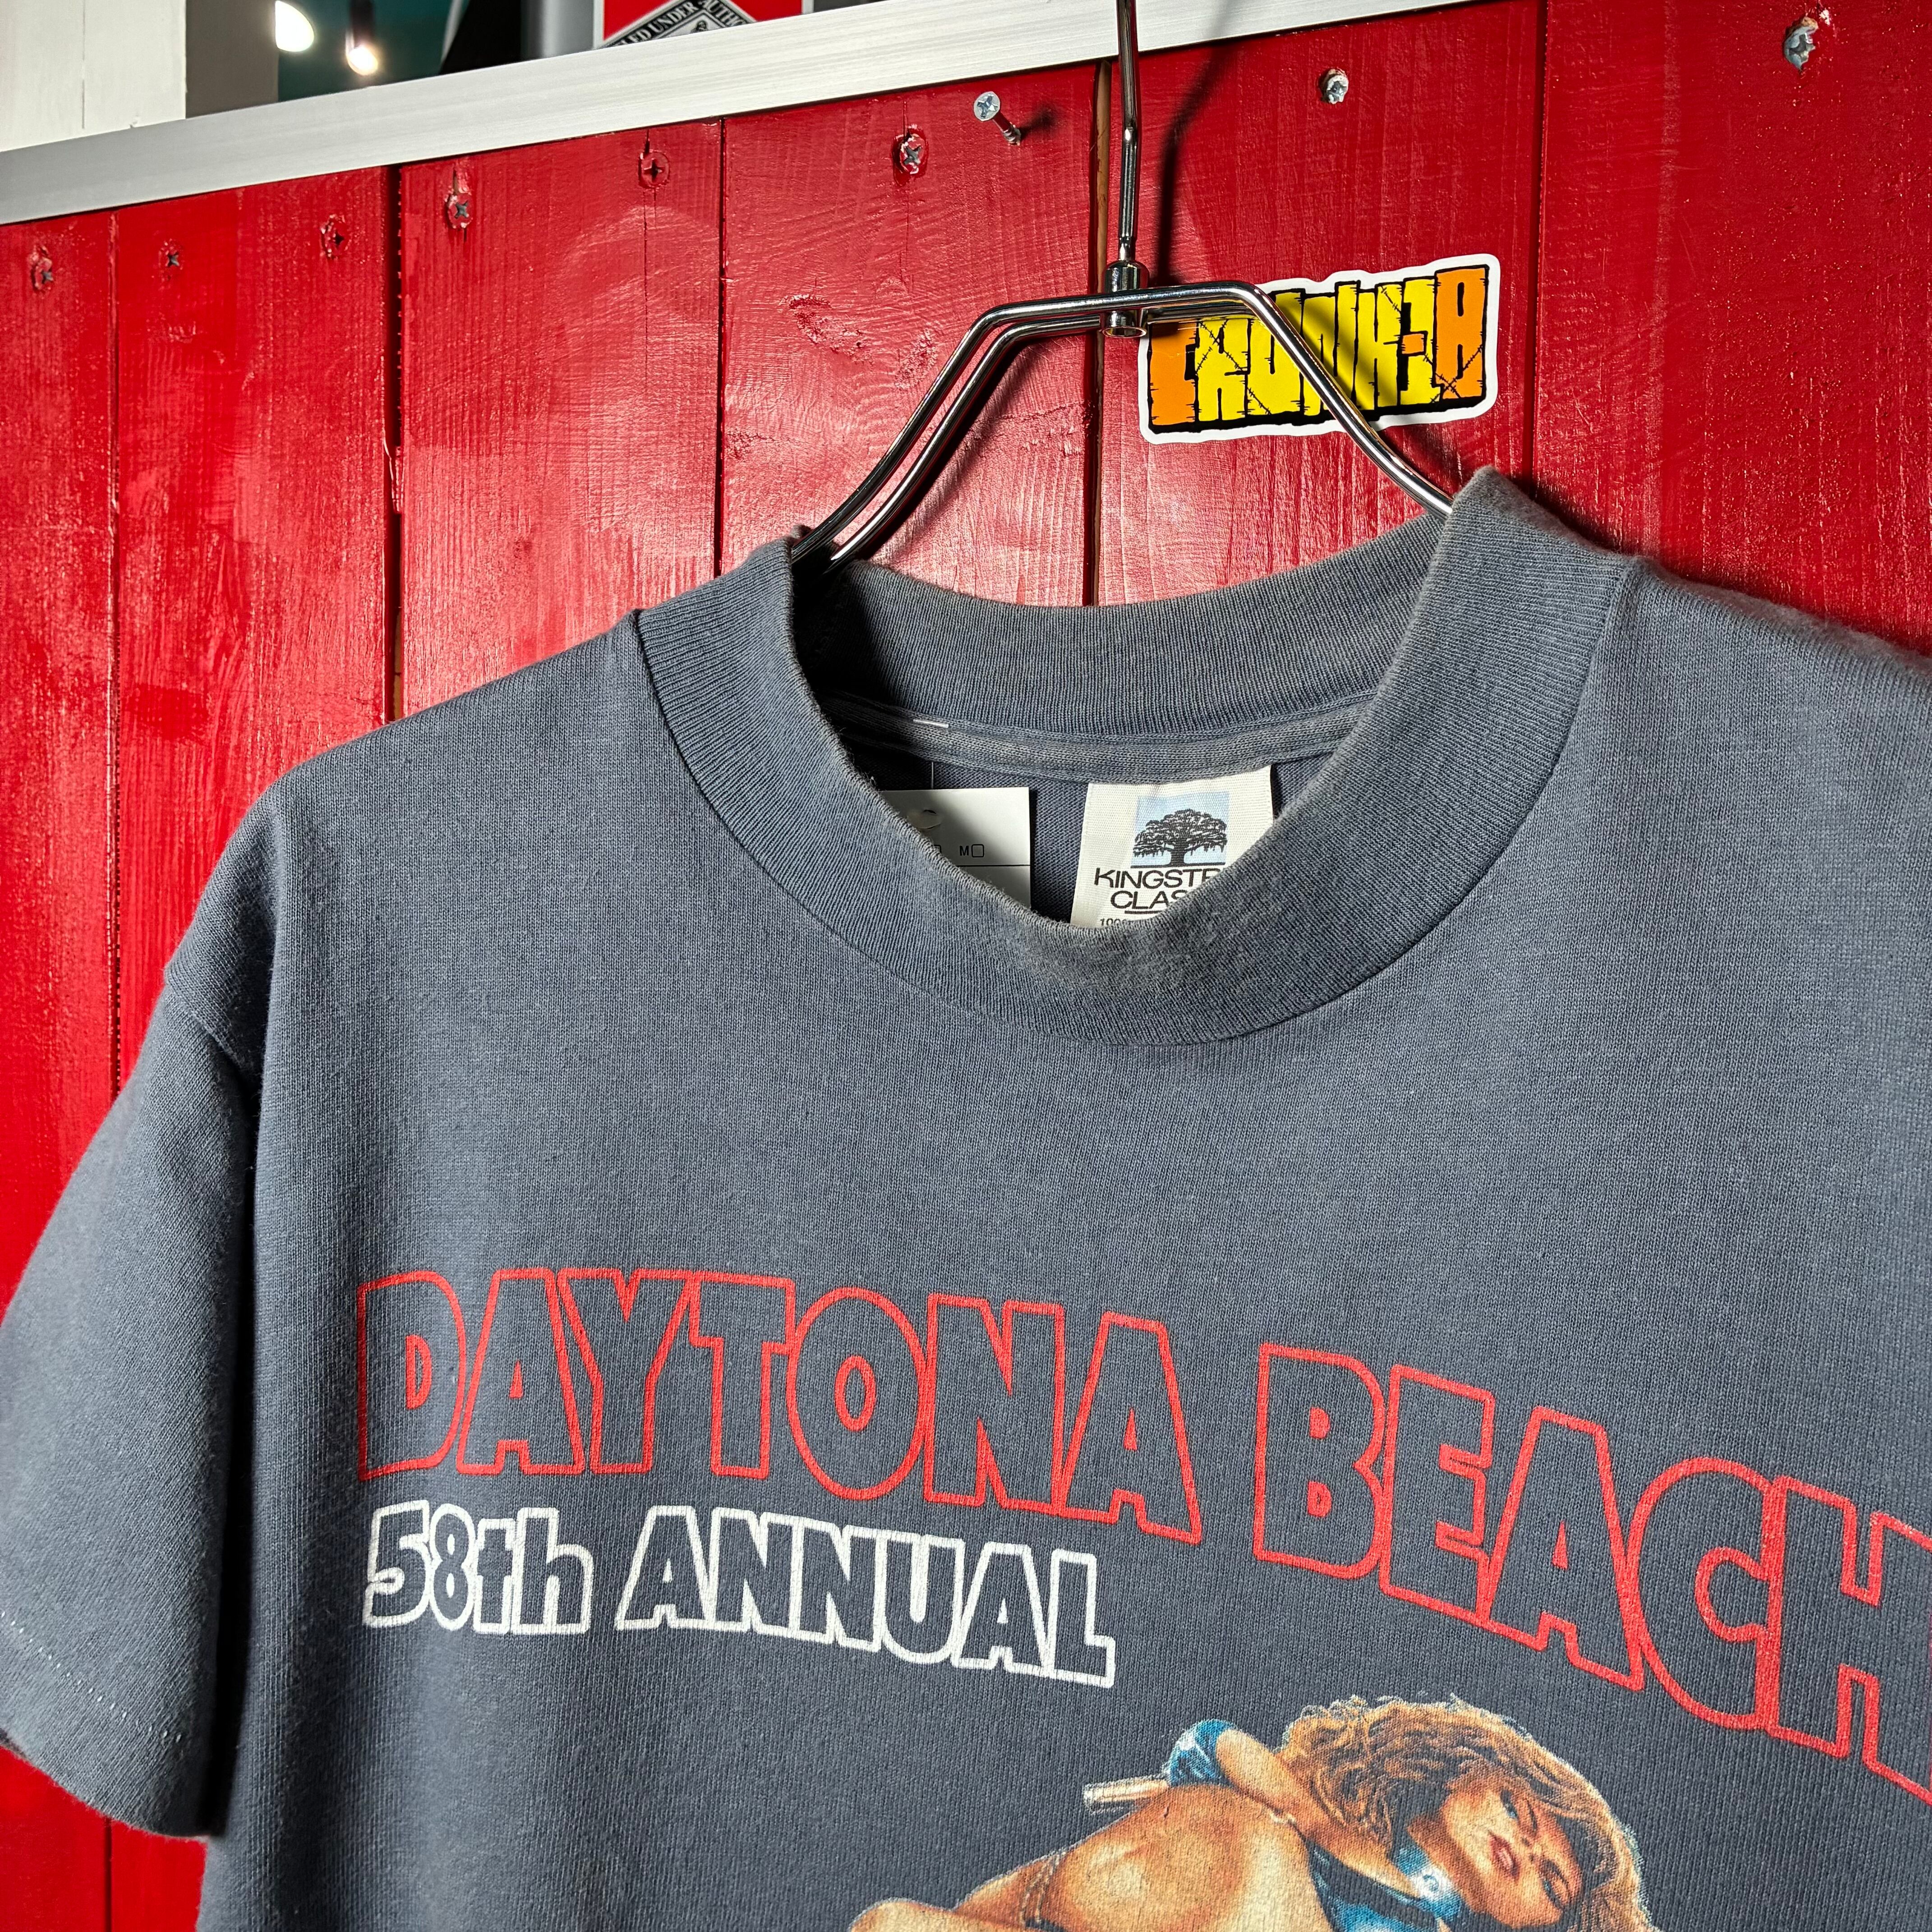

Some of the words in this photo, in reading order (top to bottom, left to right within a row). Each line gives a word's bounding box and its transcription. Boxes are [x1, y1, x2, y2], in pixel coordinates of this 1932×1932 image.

[648, 1, 699, 33] UNDER
[959, 846, 969, 856] M
[357, 1268, 1202, 1545] DAYTONA
[1253, 1343, 1932, 1805] BEACH
[363, 1500, 595, 1635] 58th
[614, 1505, 1116, 1689] ANNUAL
